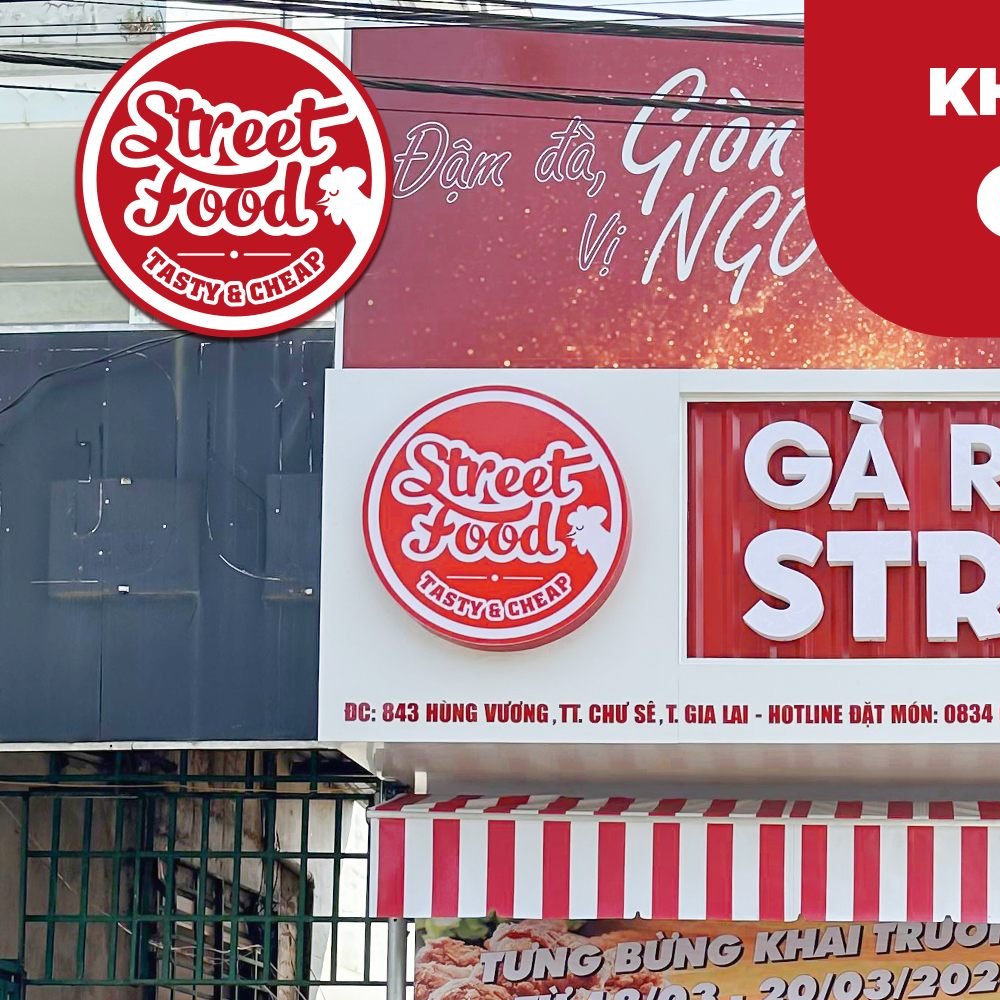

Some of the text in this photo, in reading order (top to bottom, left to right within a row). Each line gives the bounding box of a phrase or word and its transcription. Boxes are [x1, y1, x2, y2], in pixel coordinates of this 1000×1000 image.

[392, 68, 797, 215] Đậm đà, Giòn
[579, 213, 627, 277] Vị
[398, 440, 594, 523] Street
[743, 401, 910, 512] GÀ
[408, 500, 560, 557] Food
[420, 572, 569, 618] TASTY & CHEAP
[344, 702, 376, 722] ĐC:
[382, 702, 419, 723] 843
[425, 700, 478, 724] HÙNG
[588, 701, 630, 724] CHƯ
[684, 704, 717, 724] GIA
[722, 704, 749, 725] LAI
[768, 704, 843, 725] HOTLINE
[848, 701, 885, 728] ĐẶT
[891, 701, 938, 724] MÓN:
[944, 703, 994, 724] 0834
[481, 942, 604, 985] TƯNG
[614, 930, 745, 975] BỪNG
[753, 923, 864, 964] KHAI
